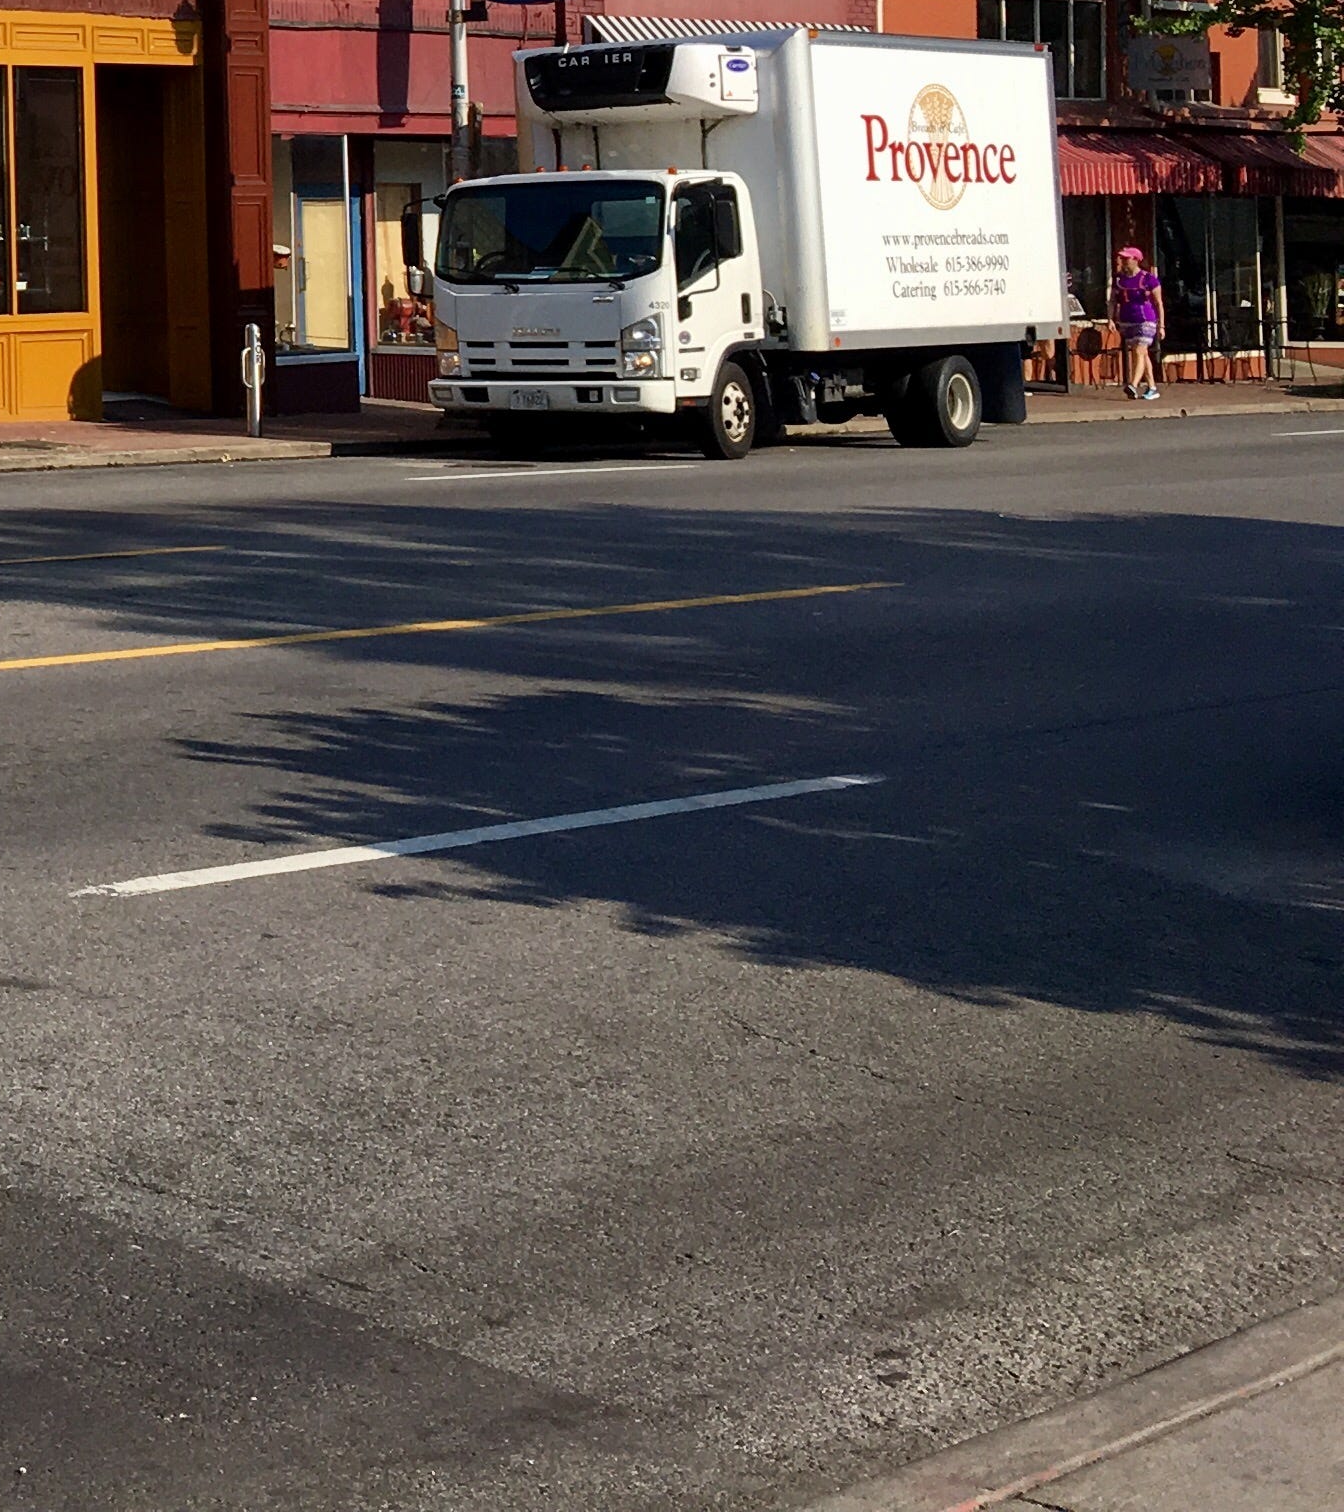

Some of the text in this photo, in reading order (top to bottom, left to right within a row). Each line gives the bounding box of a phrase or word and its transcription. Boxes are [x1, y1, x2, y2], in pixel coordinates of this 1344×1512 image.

[860, 114, 1017, 184] Provence
[882, 227, 1009, 249] www.provencebreads.com
[886, 255, 1009, 273] Wholesale 615-386-9990
[892, 279, 1006, 300] Catering 615-566-5740
